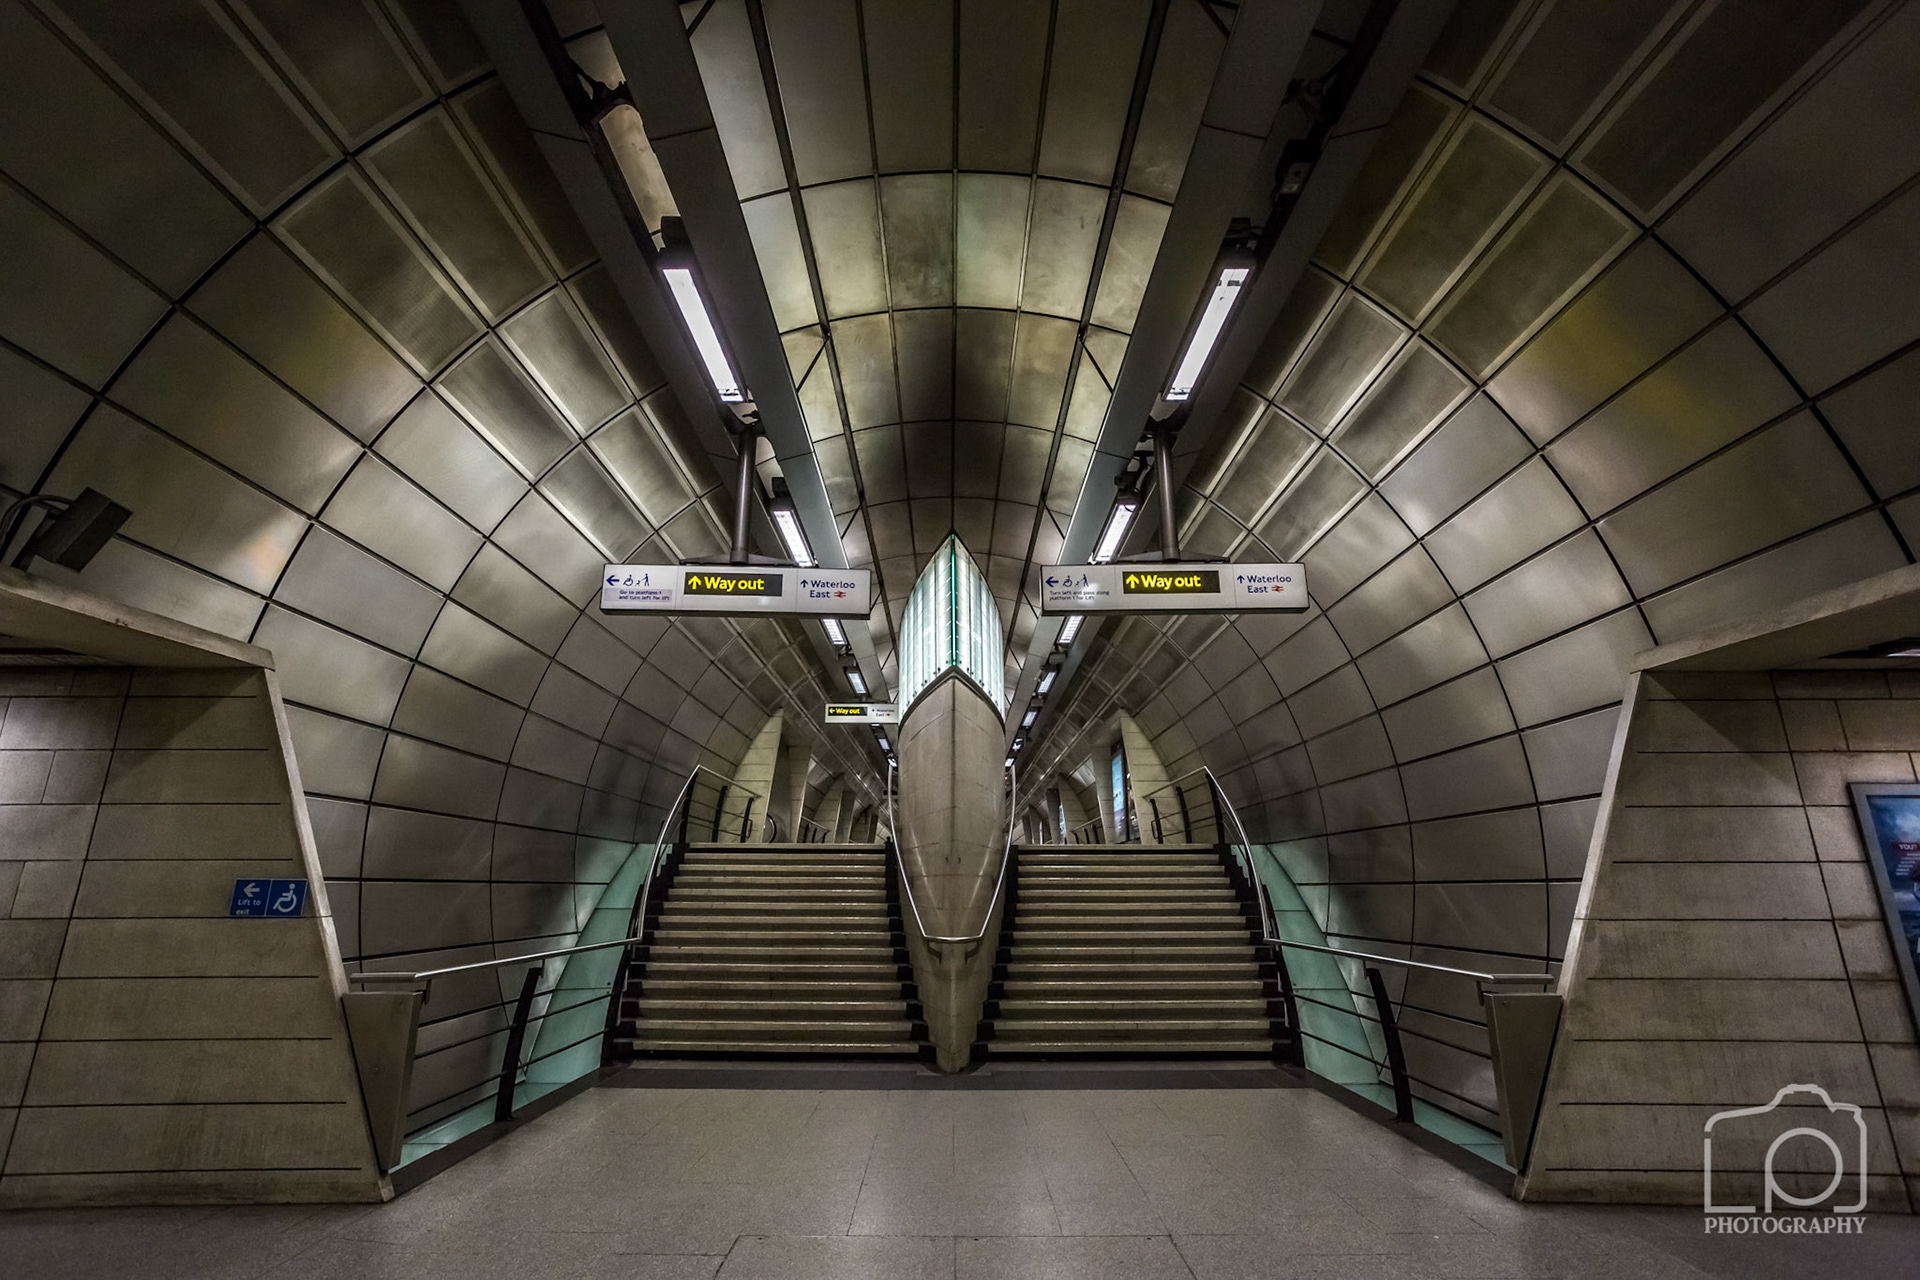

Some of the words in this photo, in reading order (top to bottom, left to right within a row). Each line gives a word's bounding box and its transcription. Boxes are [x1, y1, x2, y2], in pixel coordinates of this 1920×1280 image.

[1141, 574, 1172, 590] Way
[1174, 576, 1201, 587] out
[1247, 575, 1292, 583] Waterloo
[704, 576, 735, 592] Way
[738, 579, 764, 590] out
[811, 580, 855, 589] Waterloo
[1247, 585, 1269, 594] East
[809, 590, 831, 599] East
